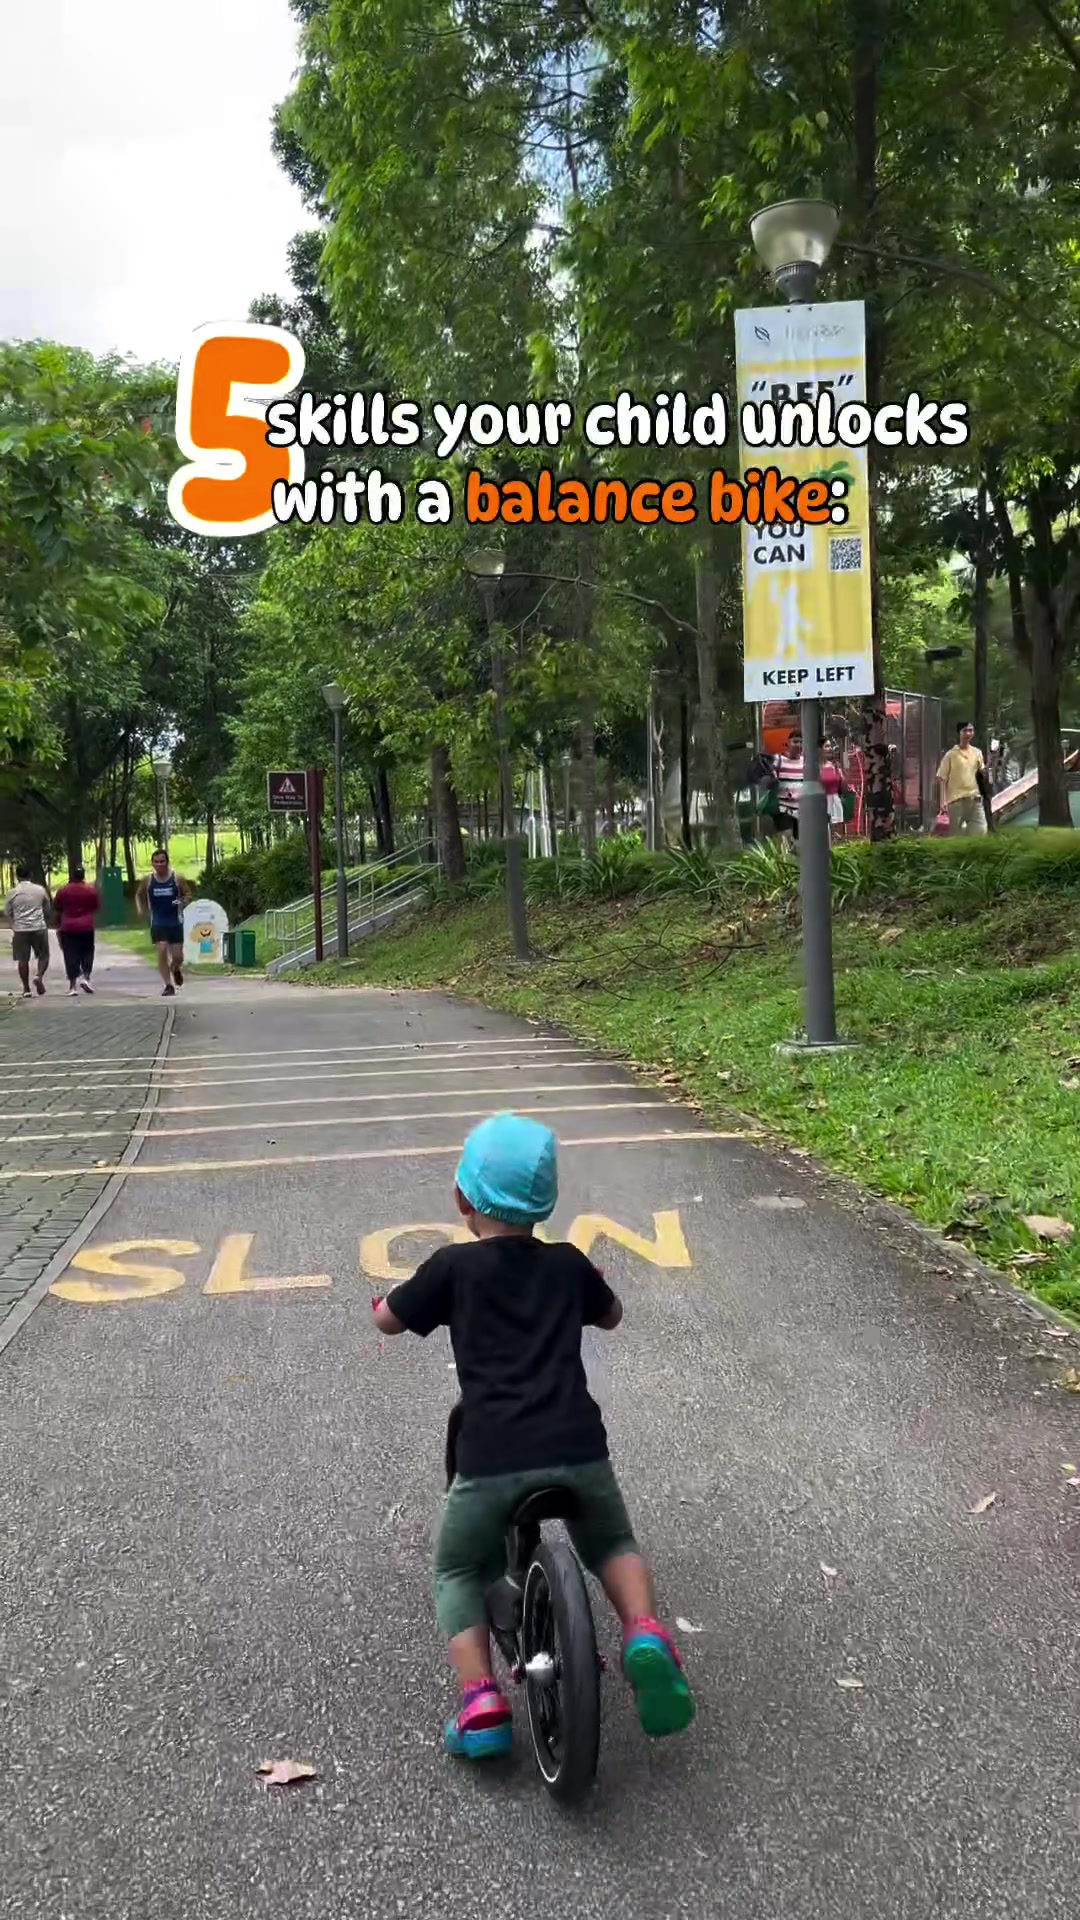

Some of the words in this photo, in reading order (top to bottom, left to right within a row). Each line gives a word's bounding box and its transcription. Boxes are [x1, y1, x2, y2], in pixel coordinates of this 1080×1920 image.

[753, 523, 805, 540] YOU
[753, 543, 805, 564] CAN
[762, 669, 809, 686] KEEP
[815, 666, 855, 682] LEFT
